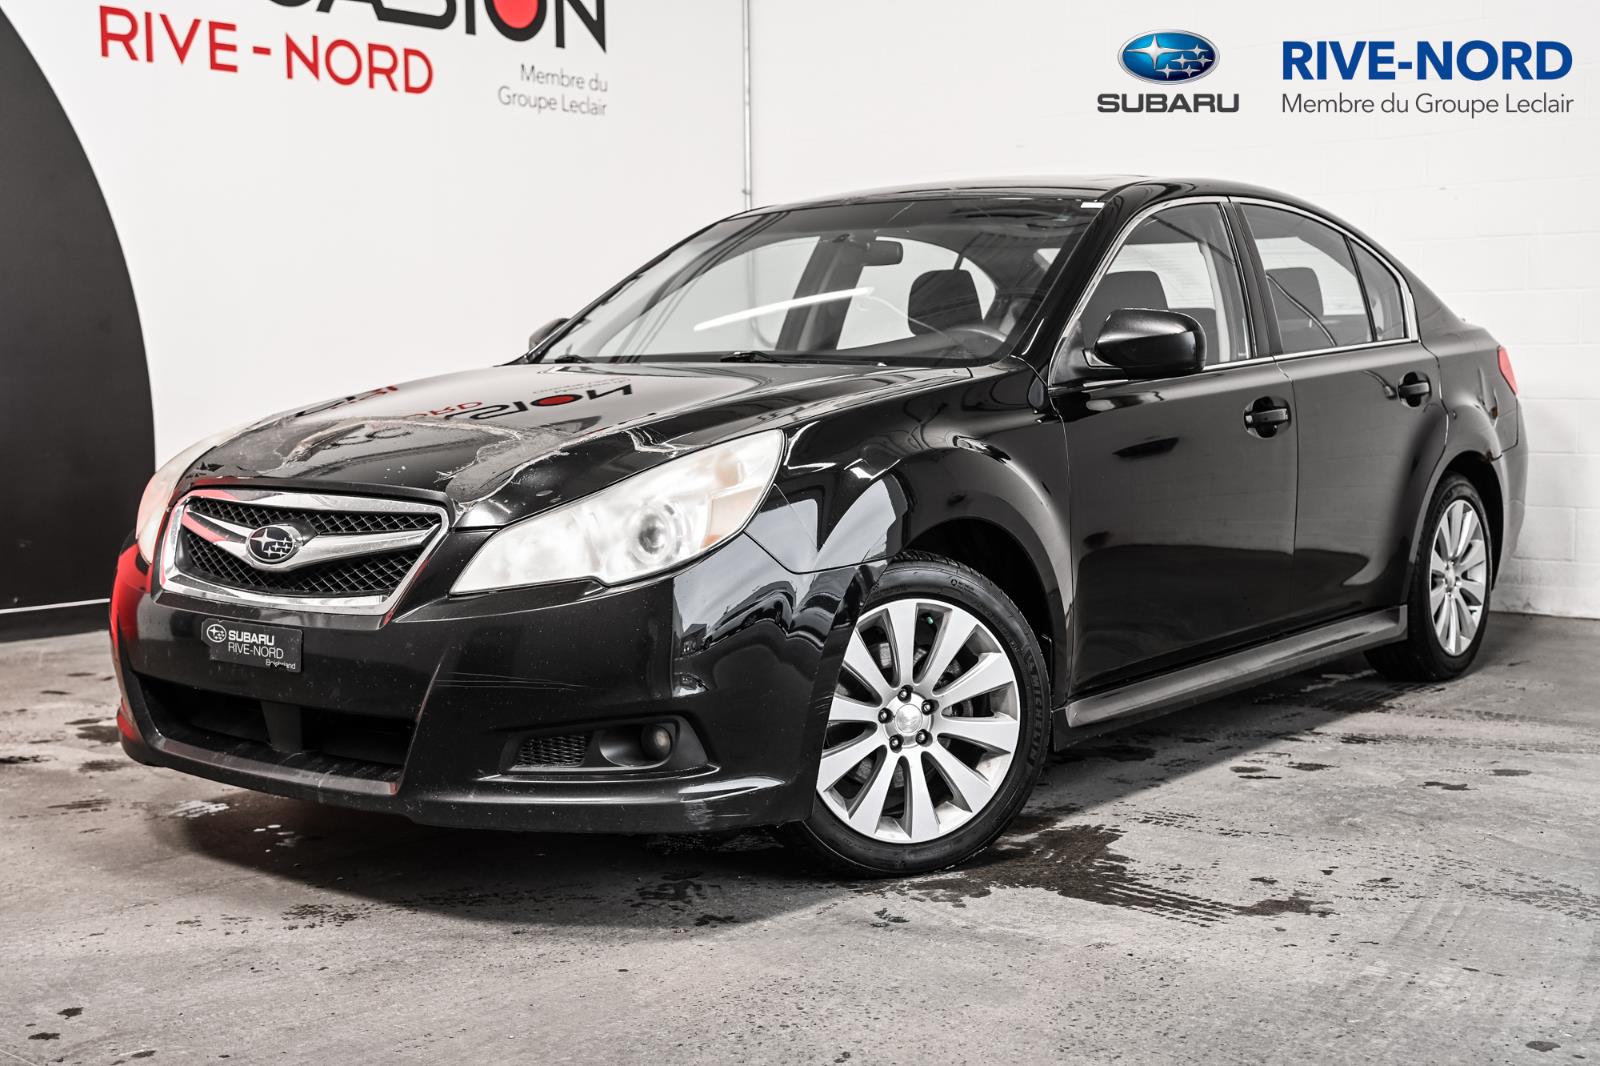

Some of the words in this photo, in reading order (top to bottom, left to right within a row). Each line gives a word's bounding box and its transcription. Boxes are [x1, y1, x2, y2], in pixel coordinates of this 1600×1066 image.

[520, 63, 585, 90] Membre
[588, 72, 608, 92] du
[497, 84, 558, 114] Groupe
[561, 92, 608, 116] Leclair
[228, 630, 275, 646] SUBARU
[227, 641, 284, 659] RIVE-NORD
